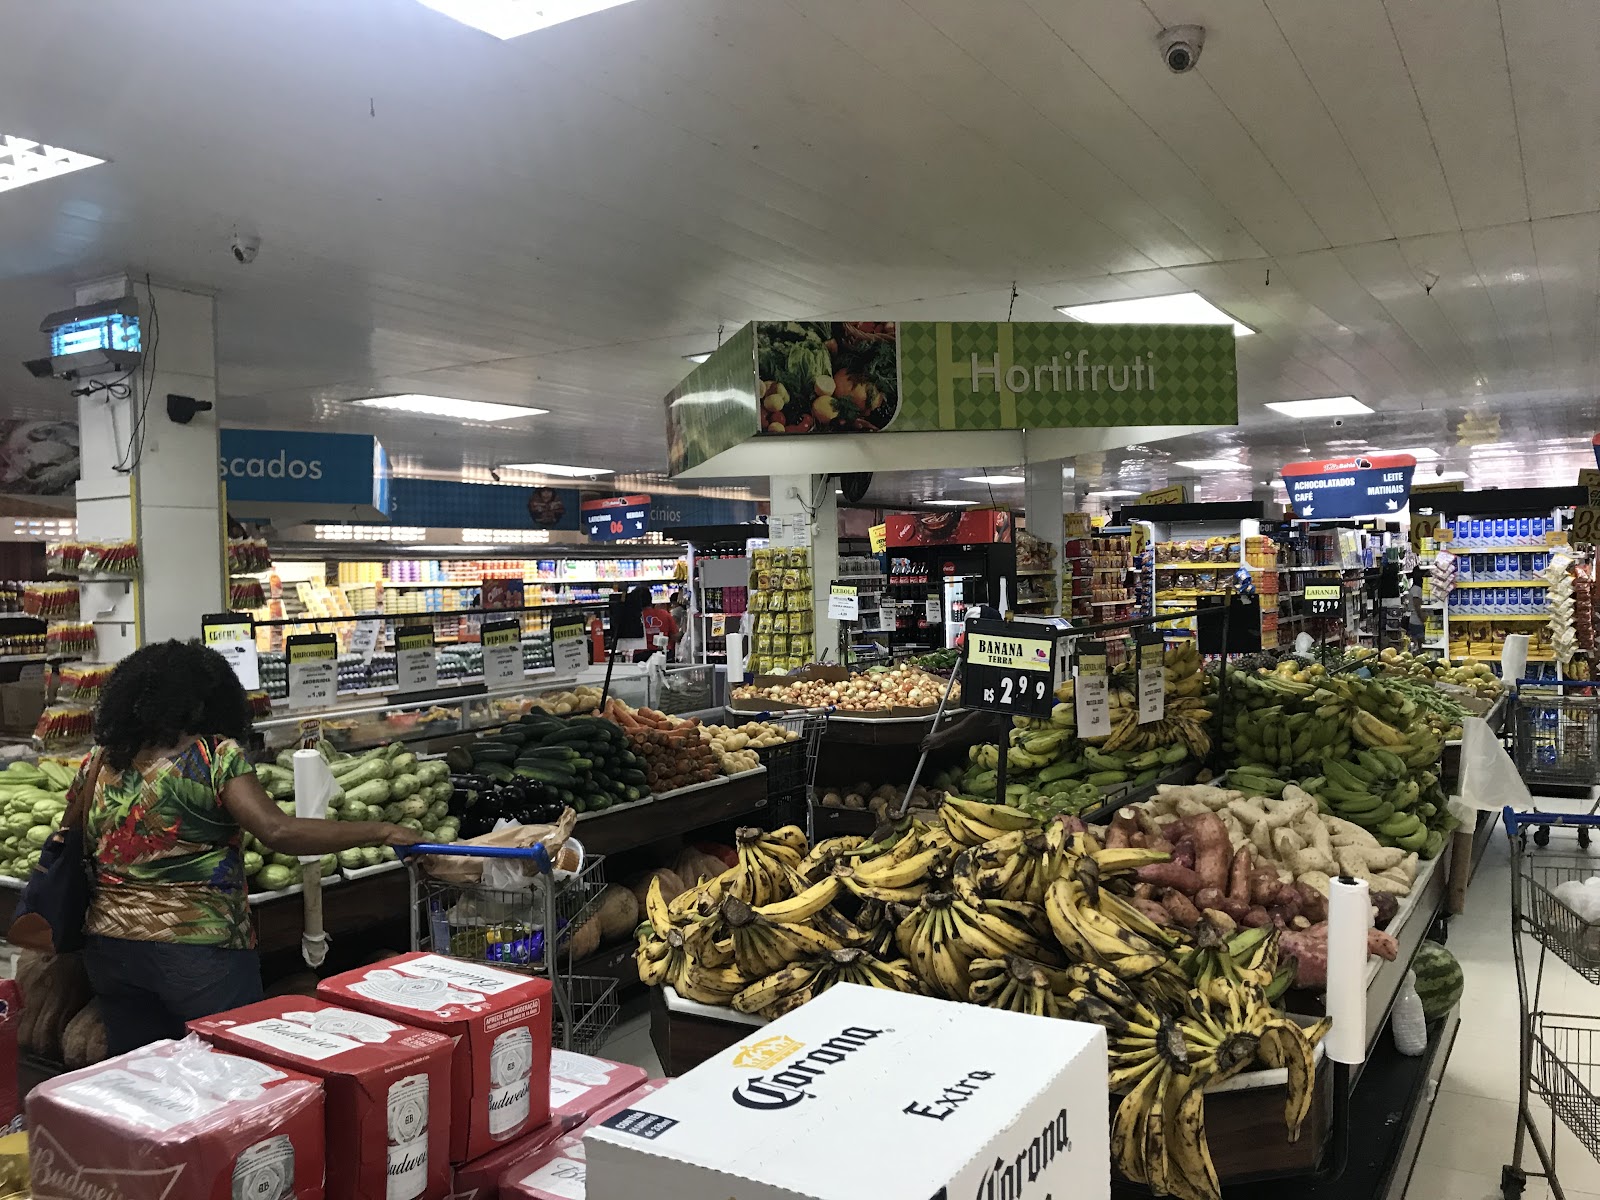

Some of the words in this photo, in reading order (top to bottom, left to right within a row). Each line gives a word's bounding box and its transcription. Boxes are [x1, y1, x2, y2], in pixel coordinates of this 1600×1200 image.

[971, 350, 1155, 393] Hortifruti
[1294, 477, 1356, 491] ACHOCOLATADOS
[1383, 472, 1404, 482] LEITE
[1294, 492, 1314, 502] CAFÉ
[1367, 485, 1405, 496] MATINAIS
[610, 520, 623, 534] 06
[832, 588, 856, 596] CEBOLA
[486, 634, 509, 645] PEPINO
[978, 639, 1024, 657] BANANA
[988, 655, 1013, 665] TERRA
[983, 688, 995, 703] R$
[485, 1014, 504, 1026] APRECIE
[503, 1009, 514, 1020] COM
[513, 1000, 539, 1015] MODERAÇÃO
[256, 1020, 341, 1049] Budweiser
[732, 1026, 885, 1110] Corona
[902, 1070, 996, 1122] Extra
